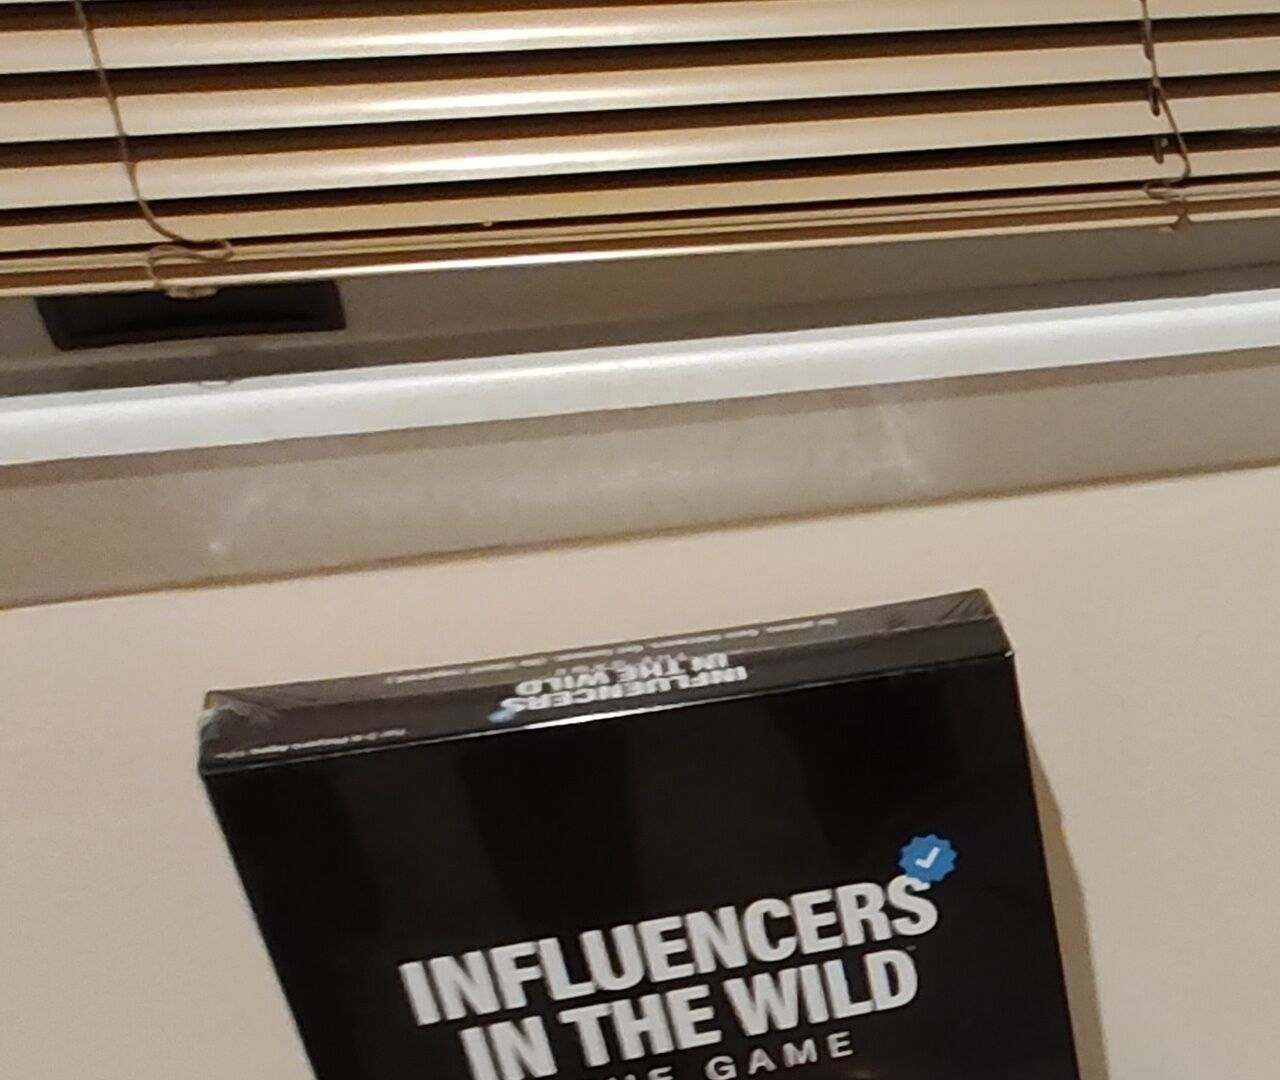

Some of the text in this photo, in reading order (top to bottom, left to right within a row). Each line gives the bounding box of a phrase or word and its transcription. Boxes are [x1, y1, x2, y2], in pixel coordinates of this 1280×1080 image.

[399, 875, 938, 1025] INFLUENCERS
[558, 987, 722, 1069] THE
[723, 950, 919, 1038] WILD
